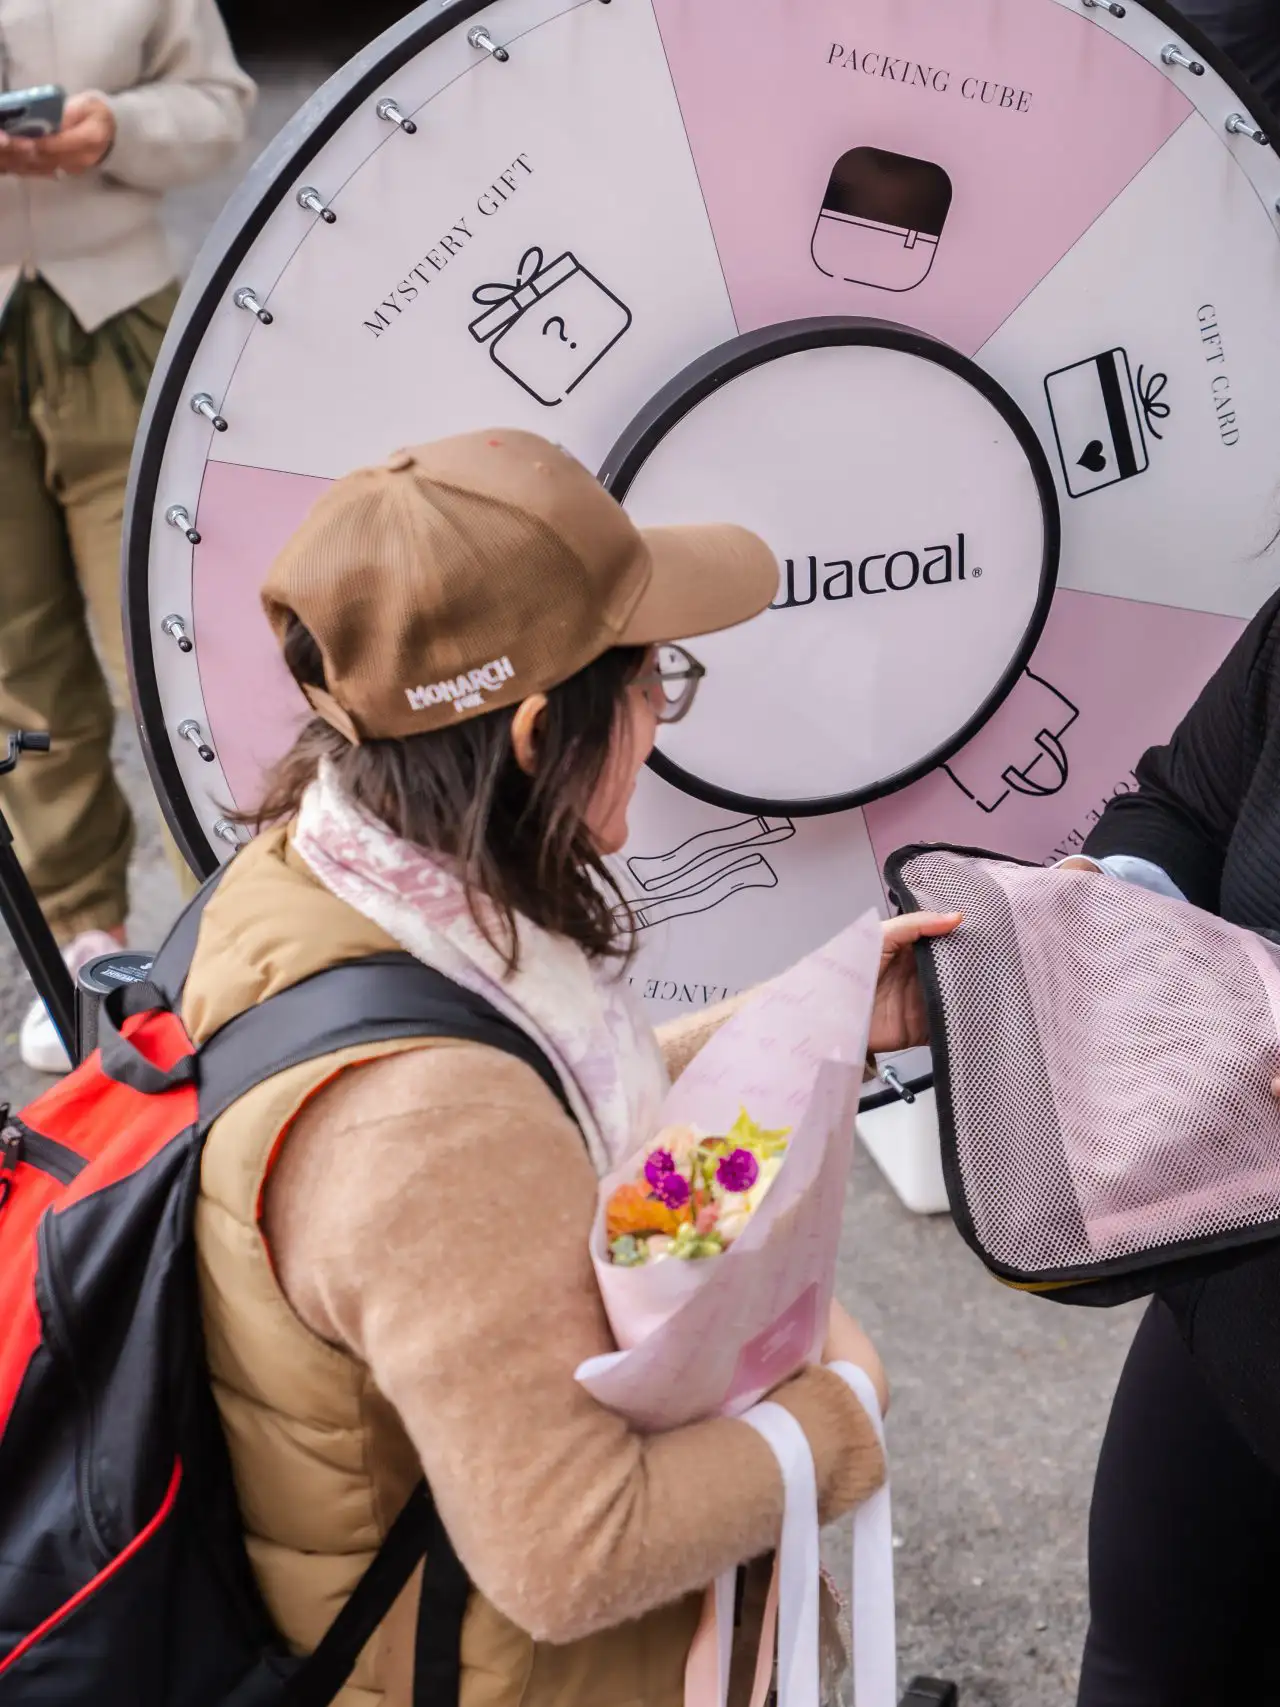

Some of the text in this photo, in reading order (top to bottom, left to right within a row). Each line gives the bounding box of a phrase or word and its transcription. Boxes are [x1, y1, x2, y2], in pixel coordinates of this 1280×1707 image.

[826, 42, 1033, 113] PACKING CUBE
[362, 153, 534, 338] MYSTERY GIFT
[1197, 304, 1240, 446] GIFT CARD
[404, 655, 516, 711] MONARCH
